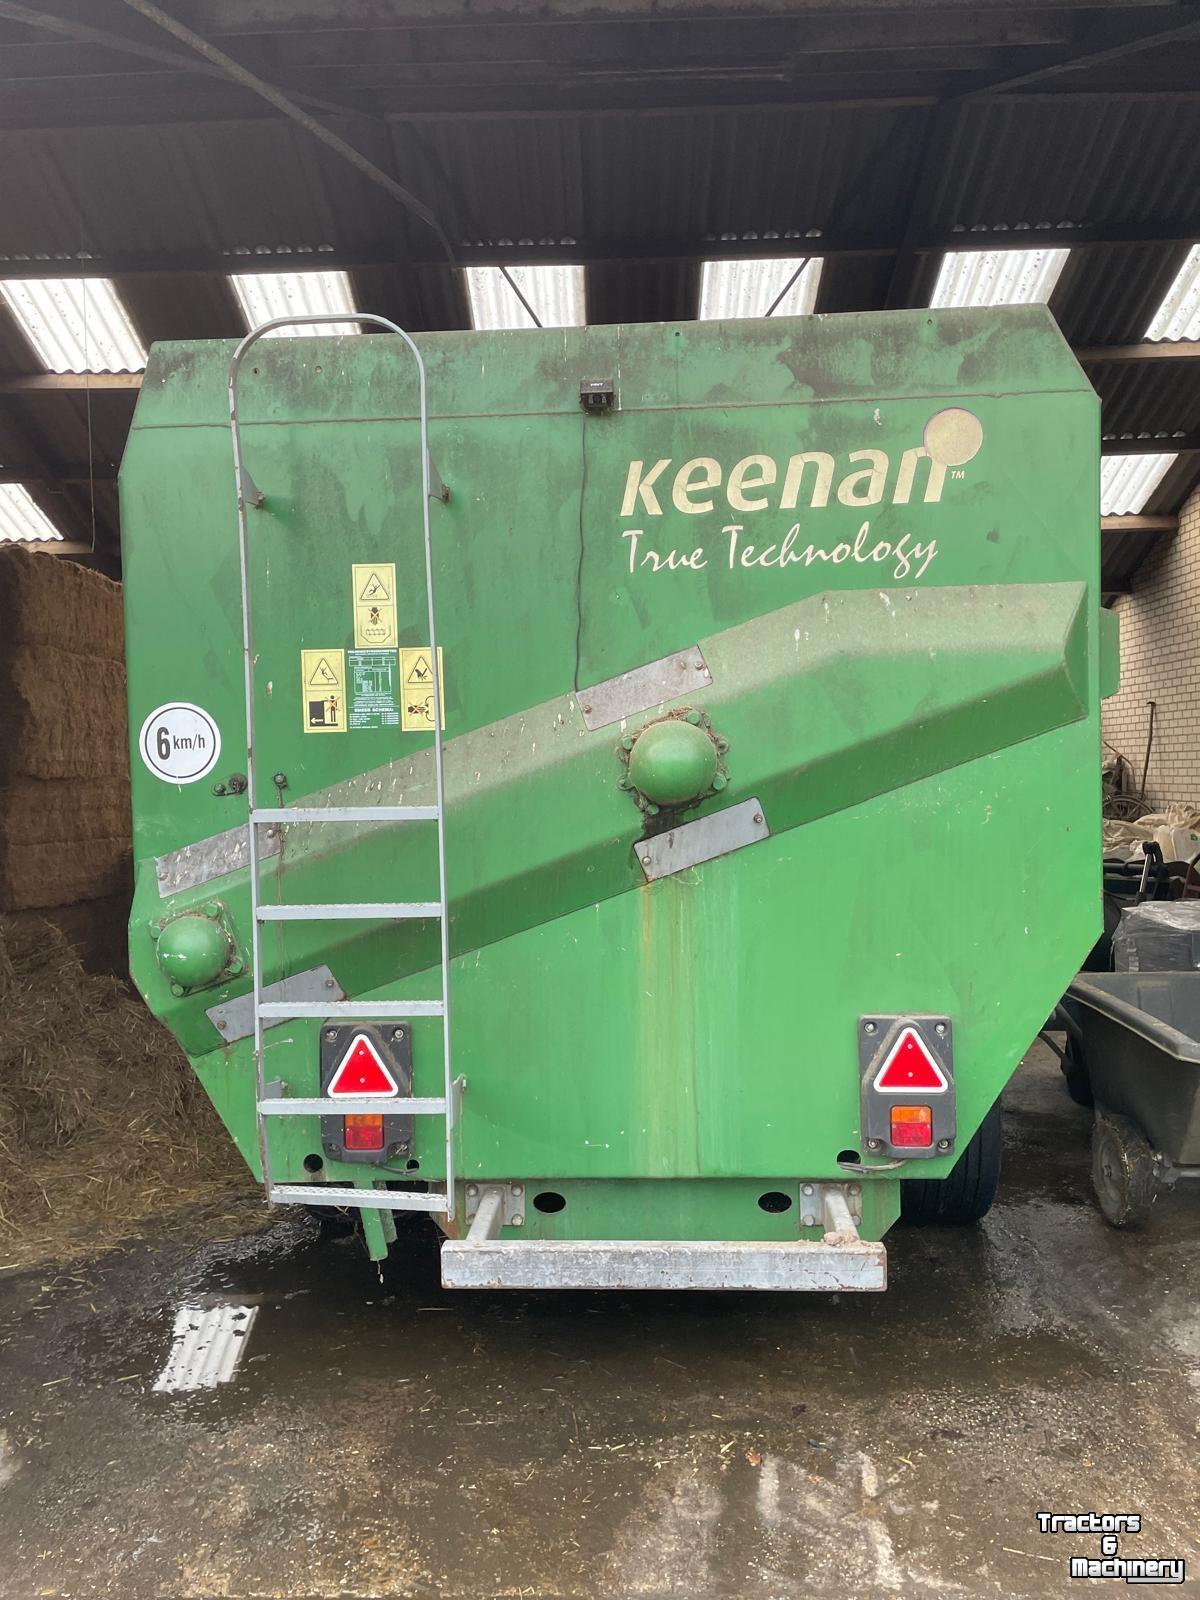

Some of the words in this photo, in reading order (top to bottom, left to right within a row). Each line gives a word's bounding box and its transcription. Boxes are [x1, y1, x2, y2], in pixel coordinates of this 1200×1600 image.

[622, 529, 707, 573] True
[721, 521, 938, 579] Technology
[157, 727, 171, 760] 6
[173, 734, 205, 750] km/h
